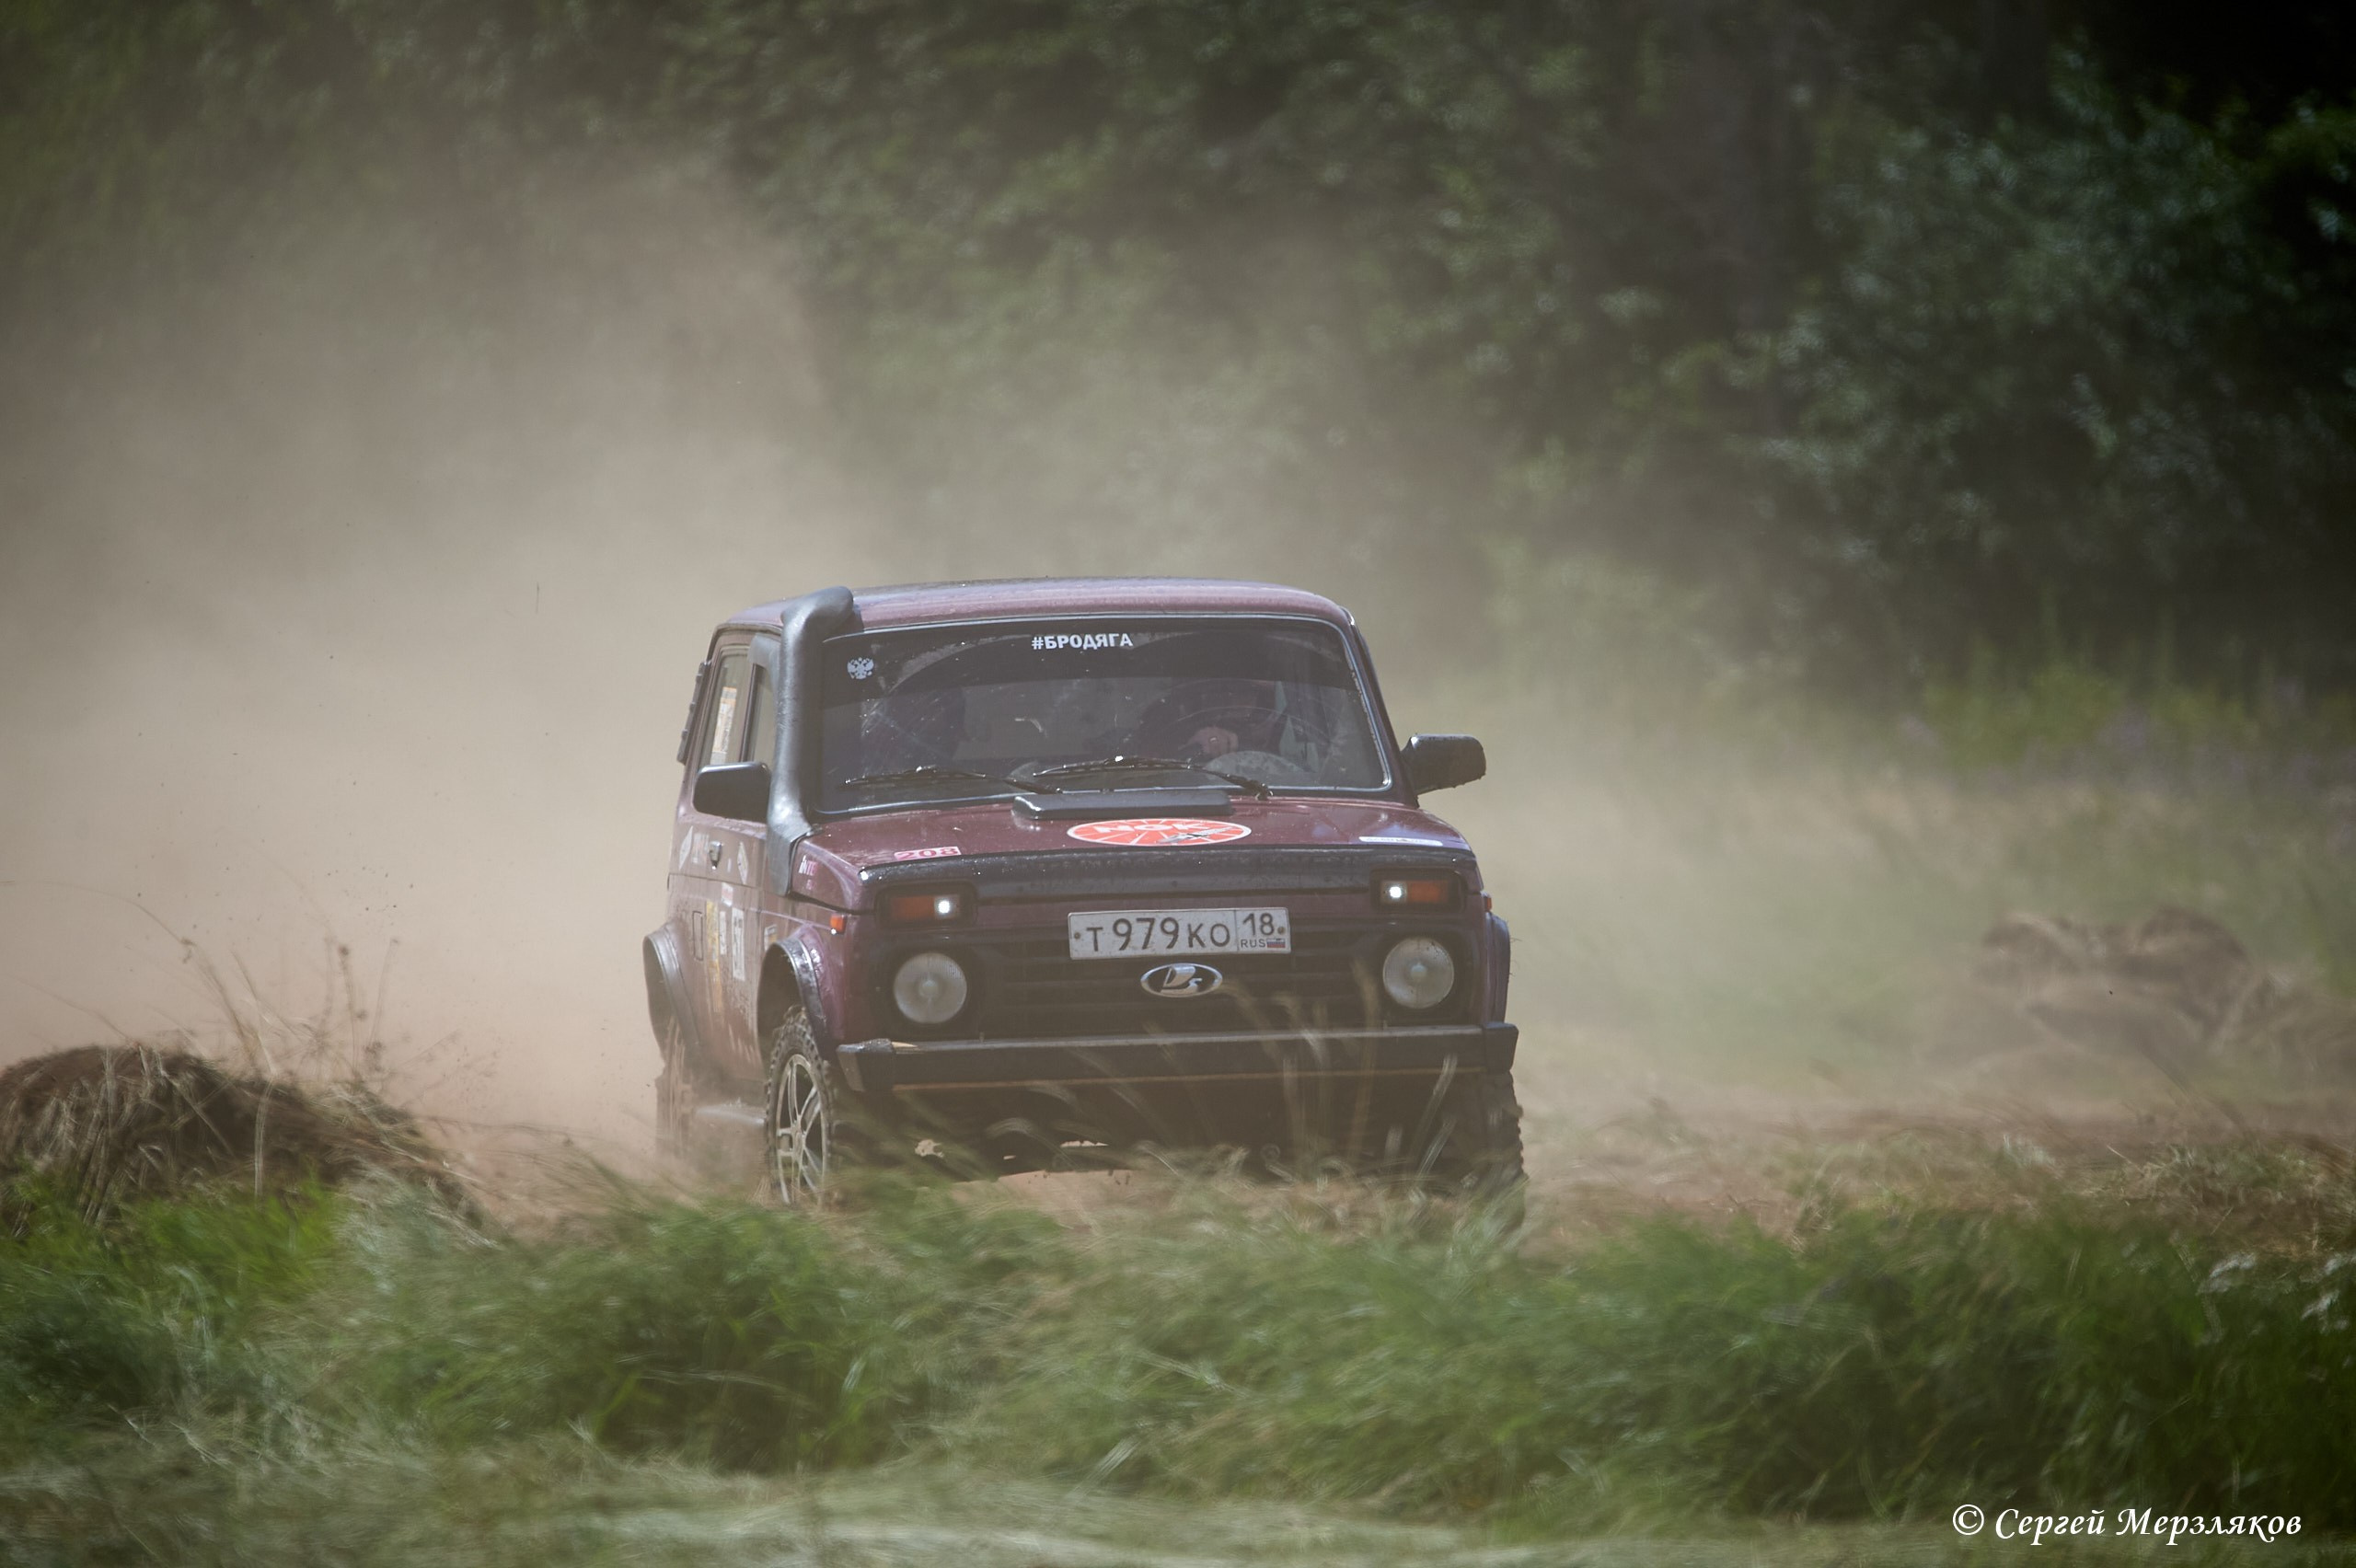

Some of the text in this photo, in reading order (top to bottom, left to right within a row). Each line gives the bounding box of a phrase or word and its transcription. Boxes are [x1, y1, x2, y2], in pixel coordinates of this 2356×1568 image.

[1031, 633, 1133, 650] #БРОДЯГА
[1242, 913, 1275, 936] 18
[1240, 938, 1266, 949] RUS
